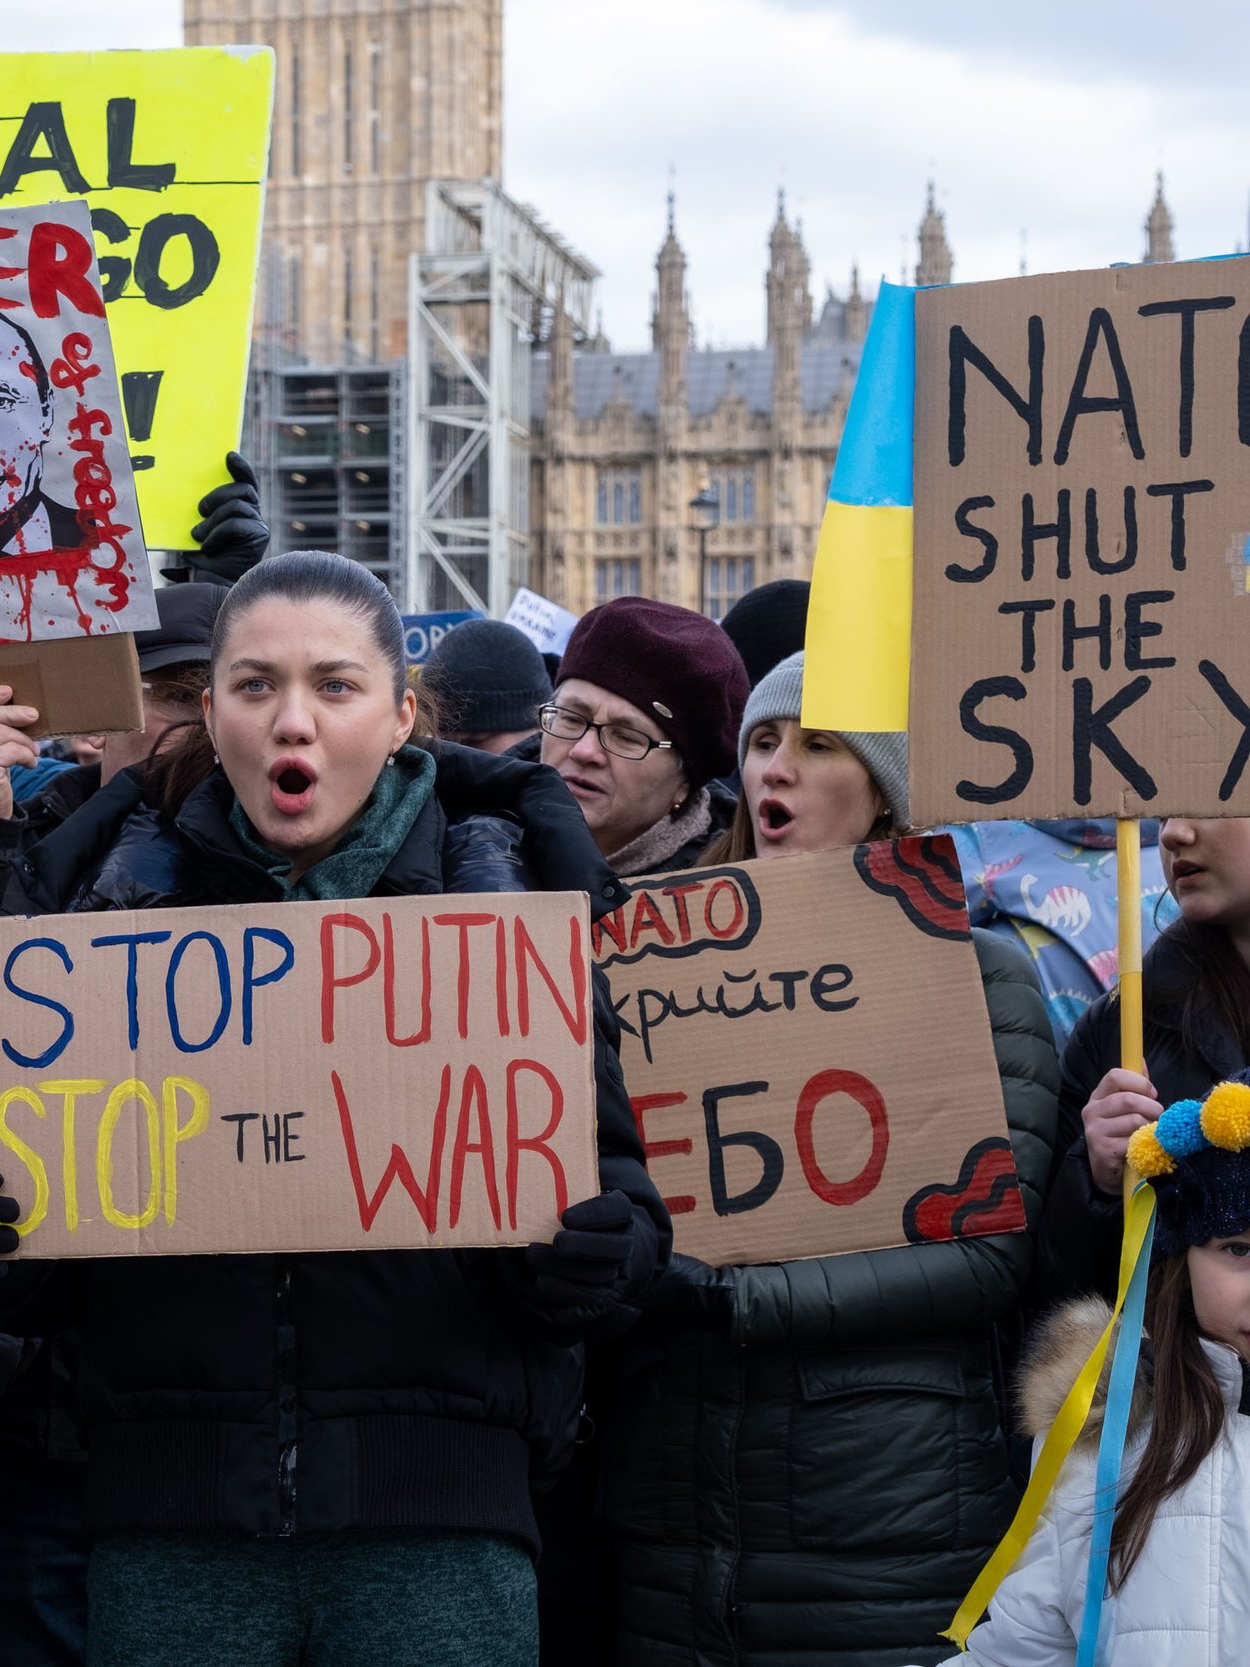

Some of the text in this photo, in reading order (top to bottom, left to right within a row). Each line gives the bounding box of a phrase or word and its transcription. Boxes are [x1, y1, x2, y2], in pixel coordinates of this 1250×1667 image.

[50, 331, 102, 398] of
[66, 402, 133, 613] freedom
[944, 479, 1215, 583] SHUT
[997, 590, 1177, 673] THE
[1, 911, 587, 1069] STOP PUTIN
[220, 1111, 307, 1164] THE
[331, 1058, 569, 1235] WAR
[628, 1067, 890, 1217] ЕБО
